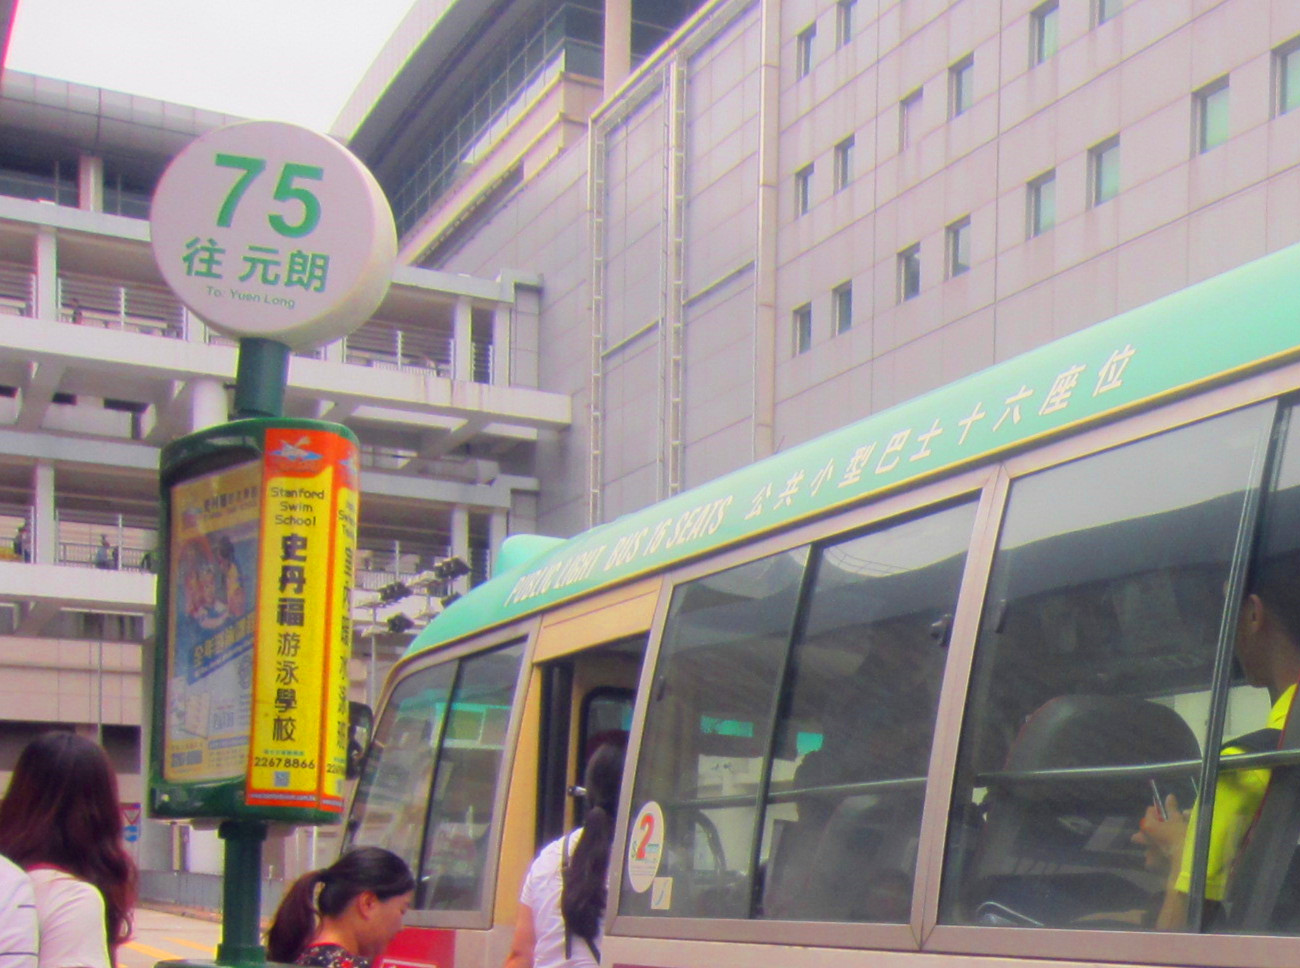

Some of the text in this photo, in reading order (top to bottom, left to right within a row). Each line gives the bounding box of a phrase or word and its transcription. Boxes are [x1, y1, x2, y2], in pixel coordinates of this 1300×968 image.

[214, 153, 324, 239] 75
[182, 237, 330, 293] 往 元朗
[206, 285, 296, 310] To Yuen Long
[270, 487, 325, 499] Stanford
[279, 501, 313, 512] Swim
[274, 515, 317, 526] School
[666, 495, 733, 549] SEATS
[272, 533, 308, 742] 史丹福游泳學校
[253, 757, 281, 768] 2267
[284, 758, 315, 769] 8866
